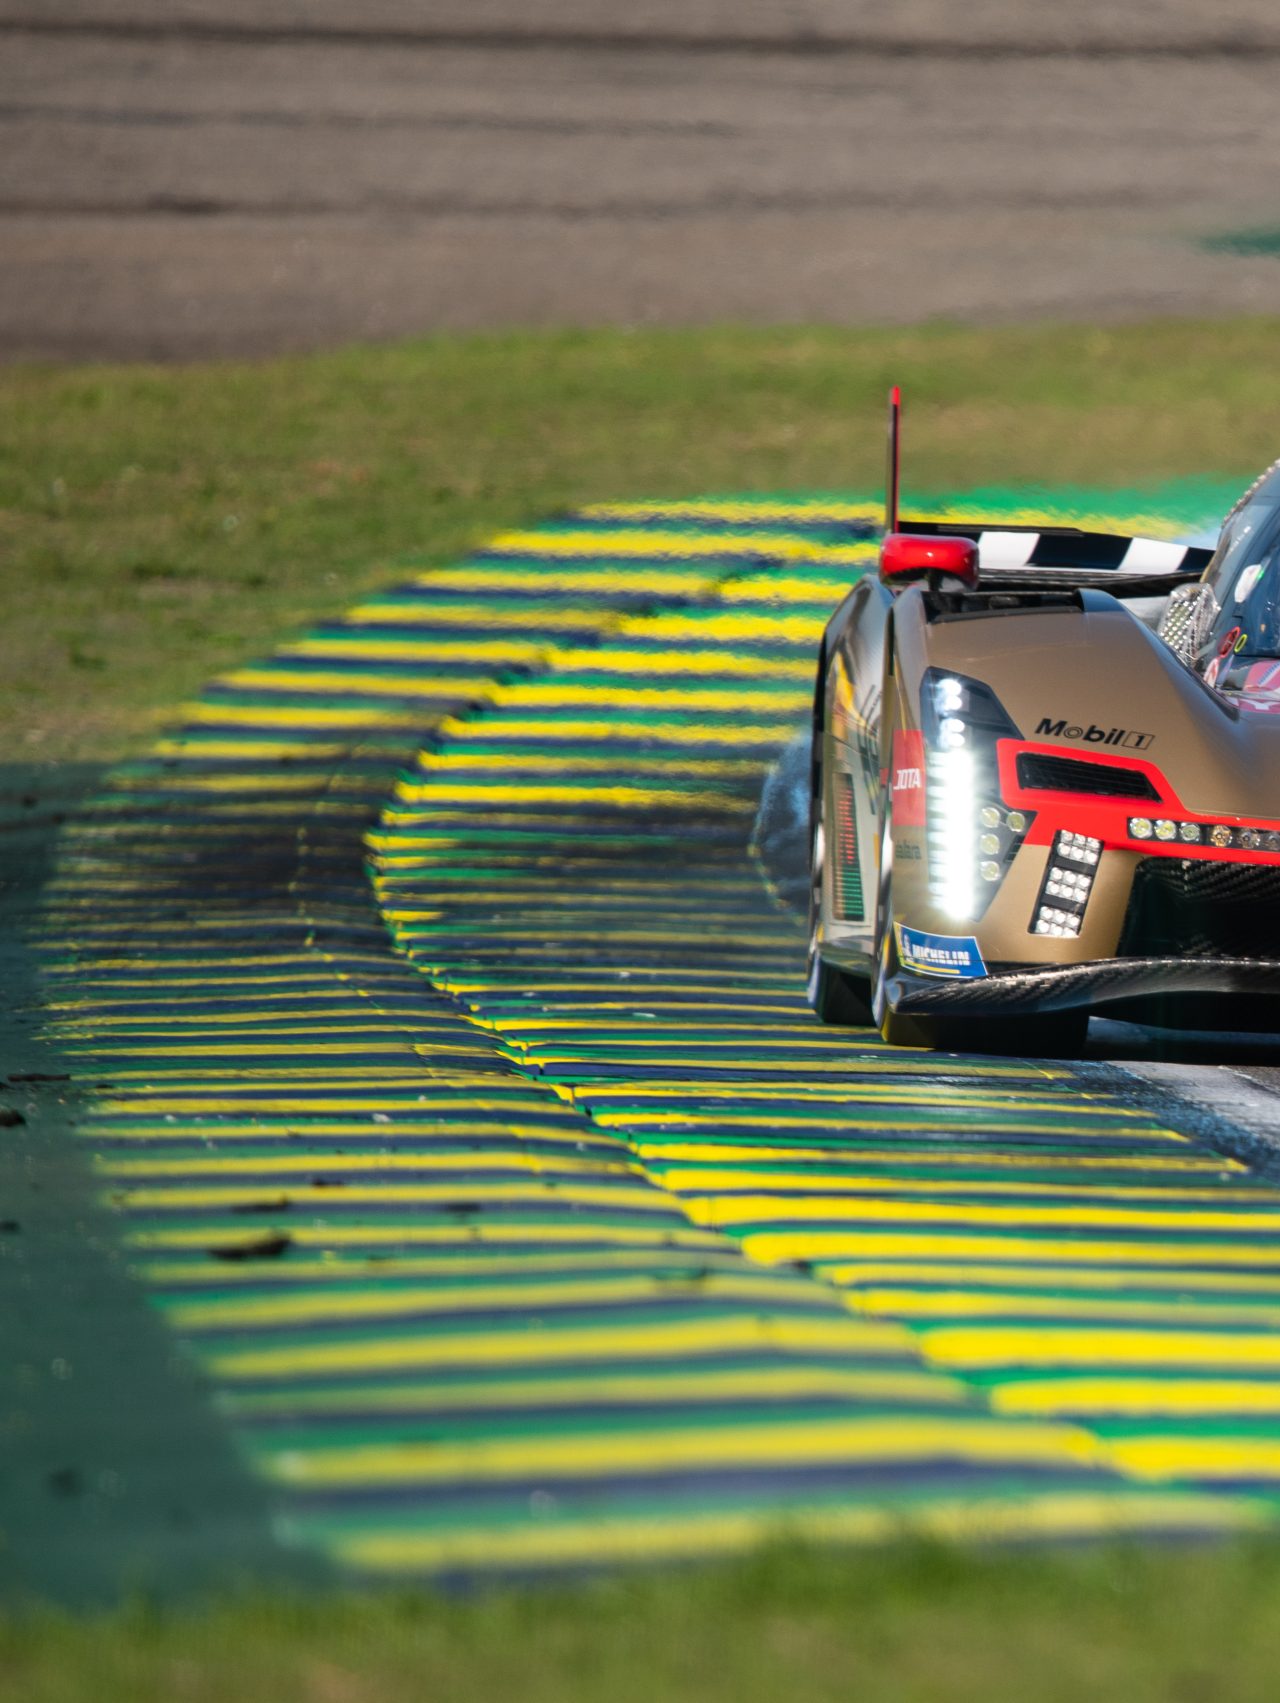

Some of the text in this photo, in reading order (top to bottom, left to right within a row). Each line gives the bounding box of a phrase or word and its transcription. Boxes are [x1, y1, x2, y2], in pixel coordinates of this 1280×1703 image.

[1034, 717, 1126, 746] Mobil
[892, 767, 922, 791] JOTA
[911, 943, 971, 966] MICHELIN
